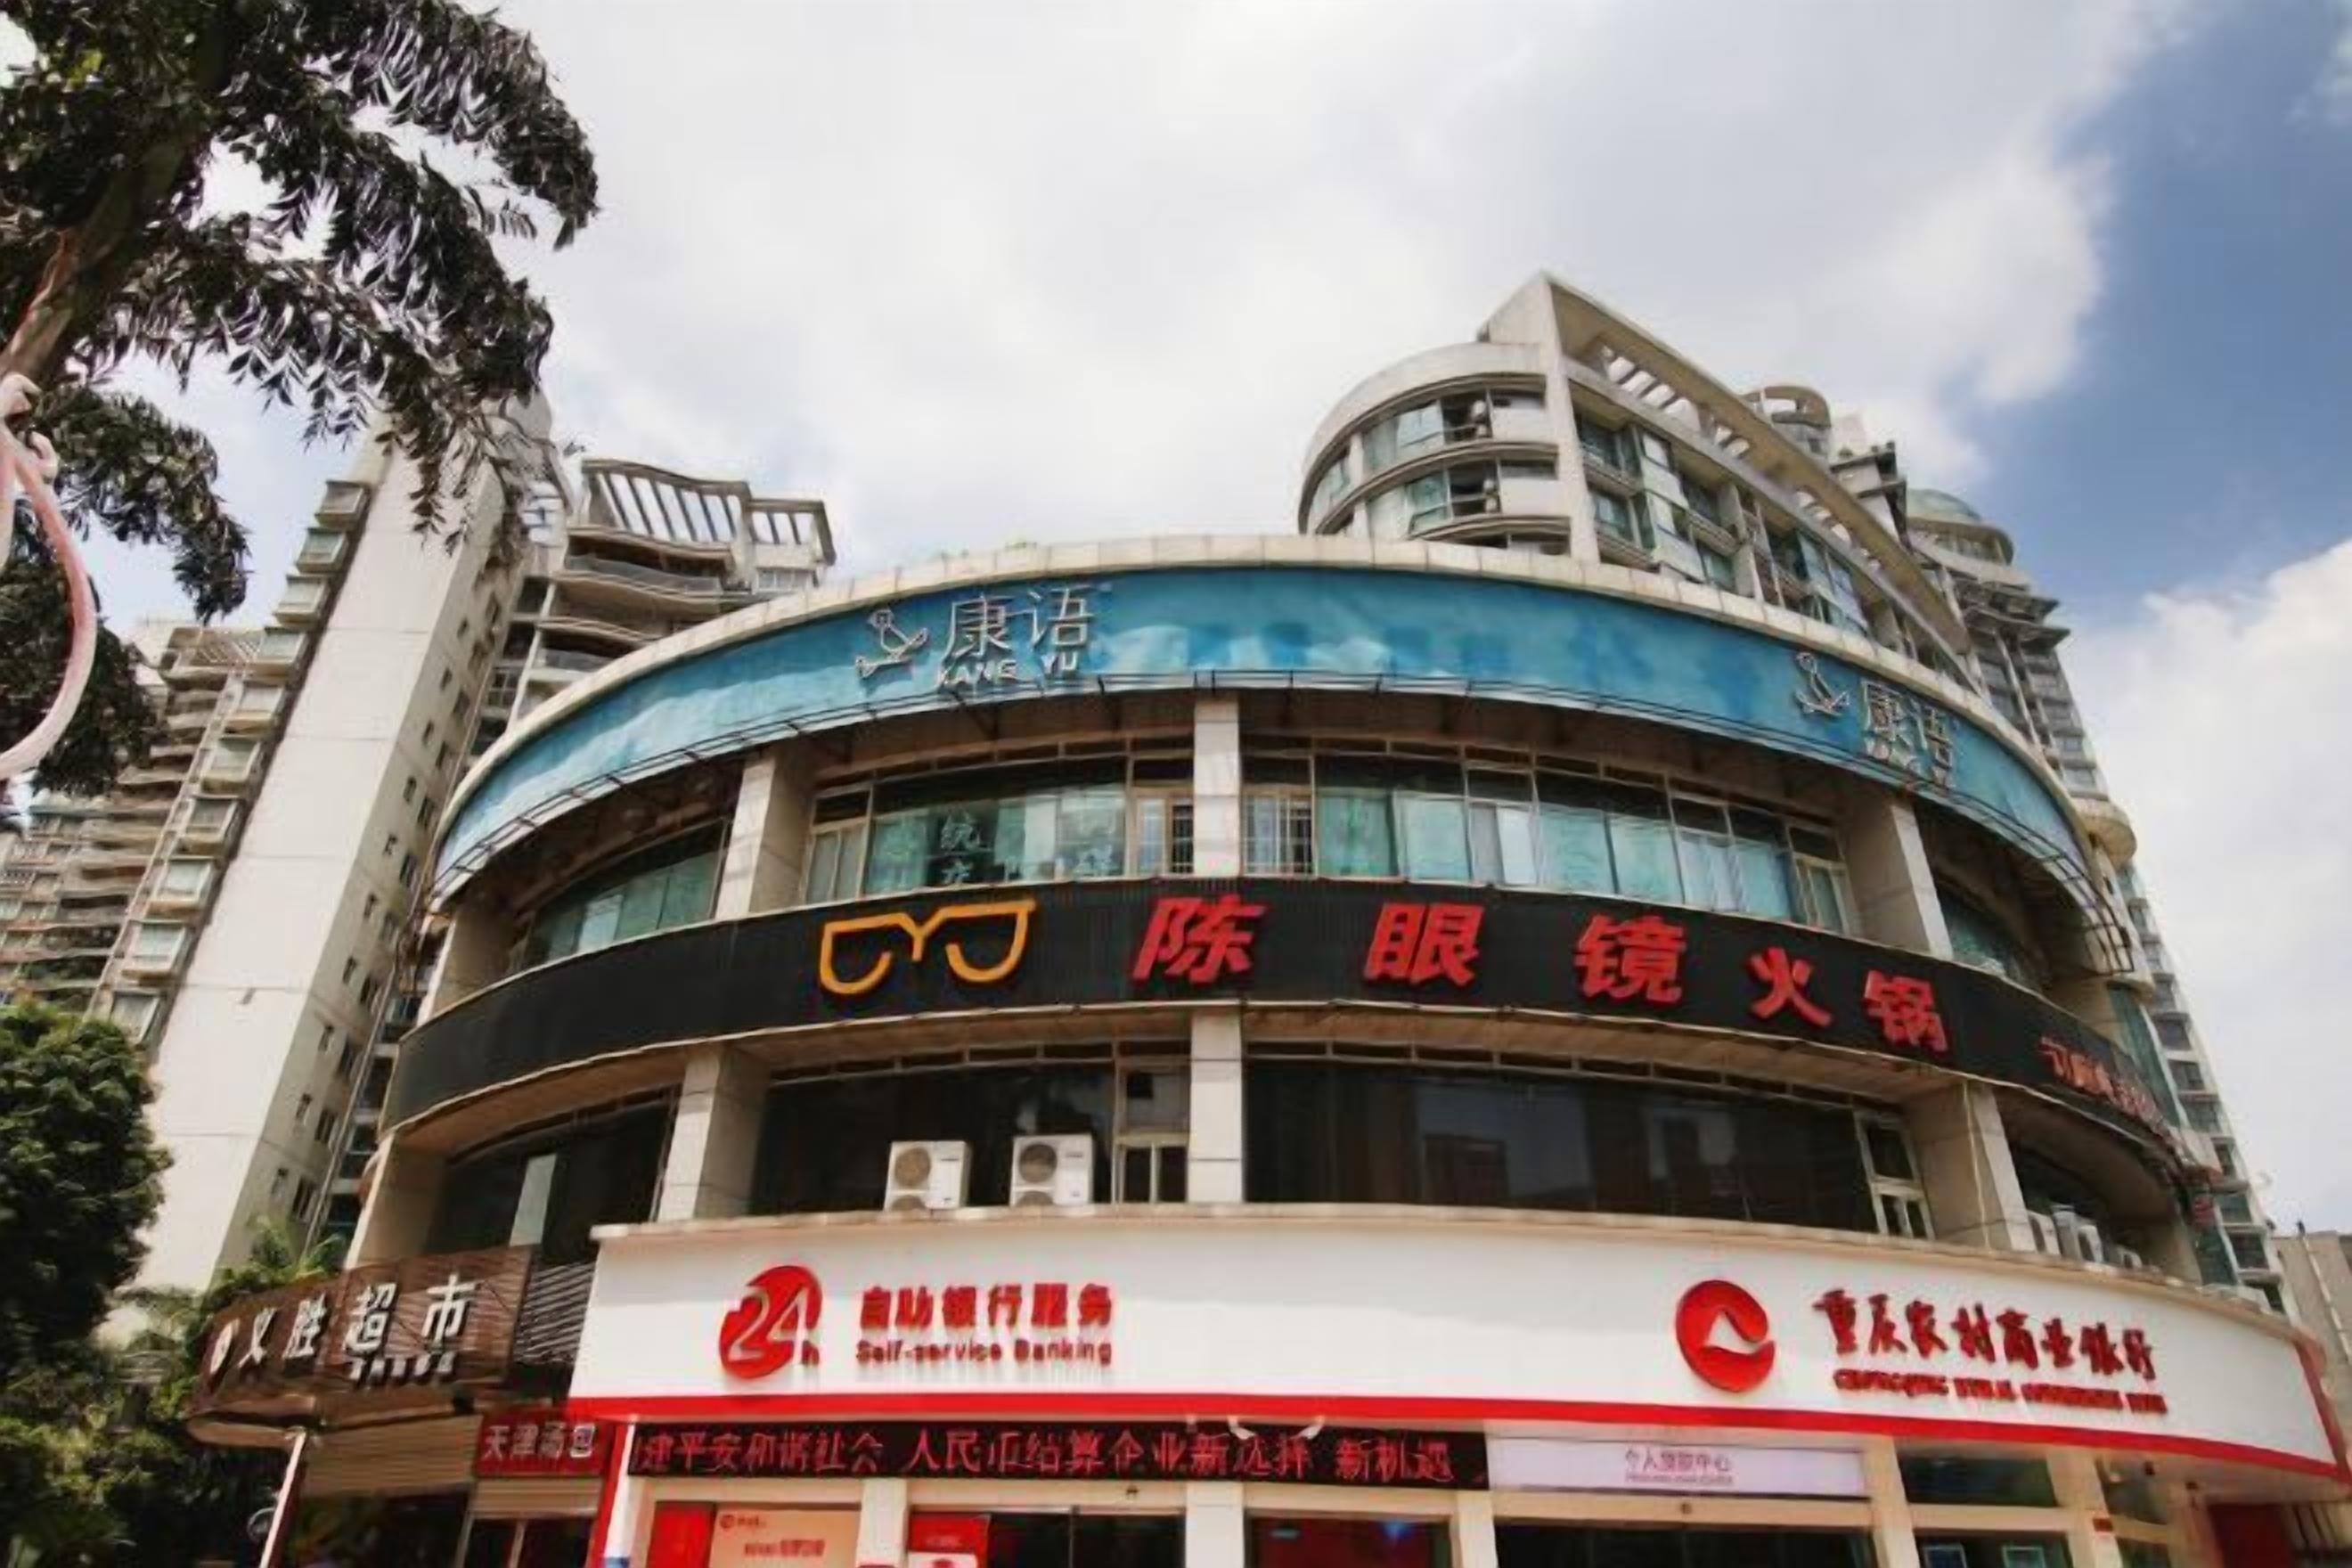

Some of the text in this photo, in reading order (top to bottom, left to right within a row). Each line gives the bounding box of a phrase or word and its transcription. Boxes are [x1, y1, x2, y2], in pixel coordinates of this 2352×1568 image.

[939, 588, 1096, 666] 康语
[1130, 891, 1949, 1053] 陈眼镜火锅
[237, 1273, 479, 1369] 义胜超市
[859, 1282, 1112, 1328] 自助银行服务
[855, 1338, 1112, 1366] Self-service Banking
